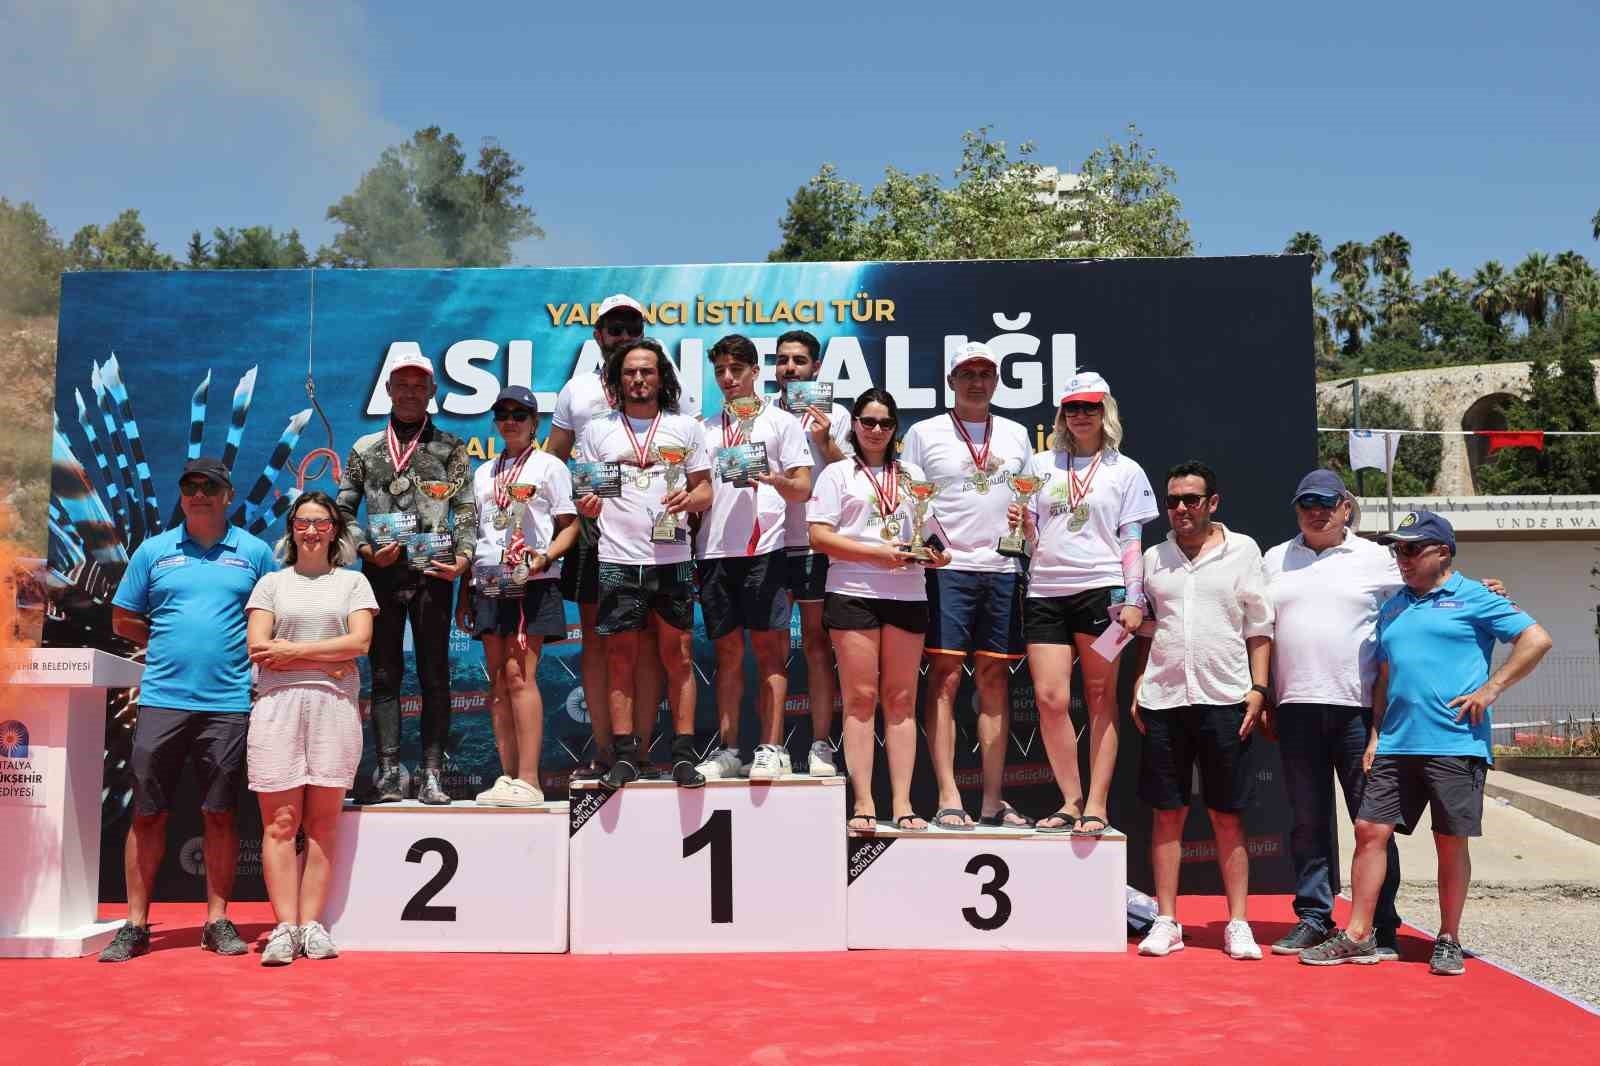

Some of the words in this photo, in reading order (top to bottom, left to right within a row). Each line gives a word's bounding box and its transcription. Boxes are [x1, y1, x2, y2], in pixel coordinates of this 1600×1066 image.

[546, 302, 688, 326] YANCI
[696, 294, 824, 324] İSTİLACI
[832, 292, 896, 322] TÜR
[1379, 500, 1470, 512] ANTALYA
[1495, 517, 1599, 529] UNDERWA
[42, 659, 91, 672] BELEDİYESİ
[0, 760, 32, 770] TALYA
[572, 792, 595, 816] SPOR
[851, 842, 873, 864] SPOR
[682, 809, 734, 924] 1
[400, 837, 460, 922] 2
[961, 853, 1013, 931] 3
